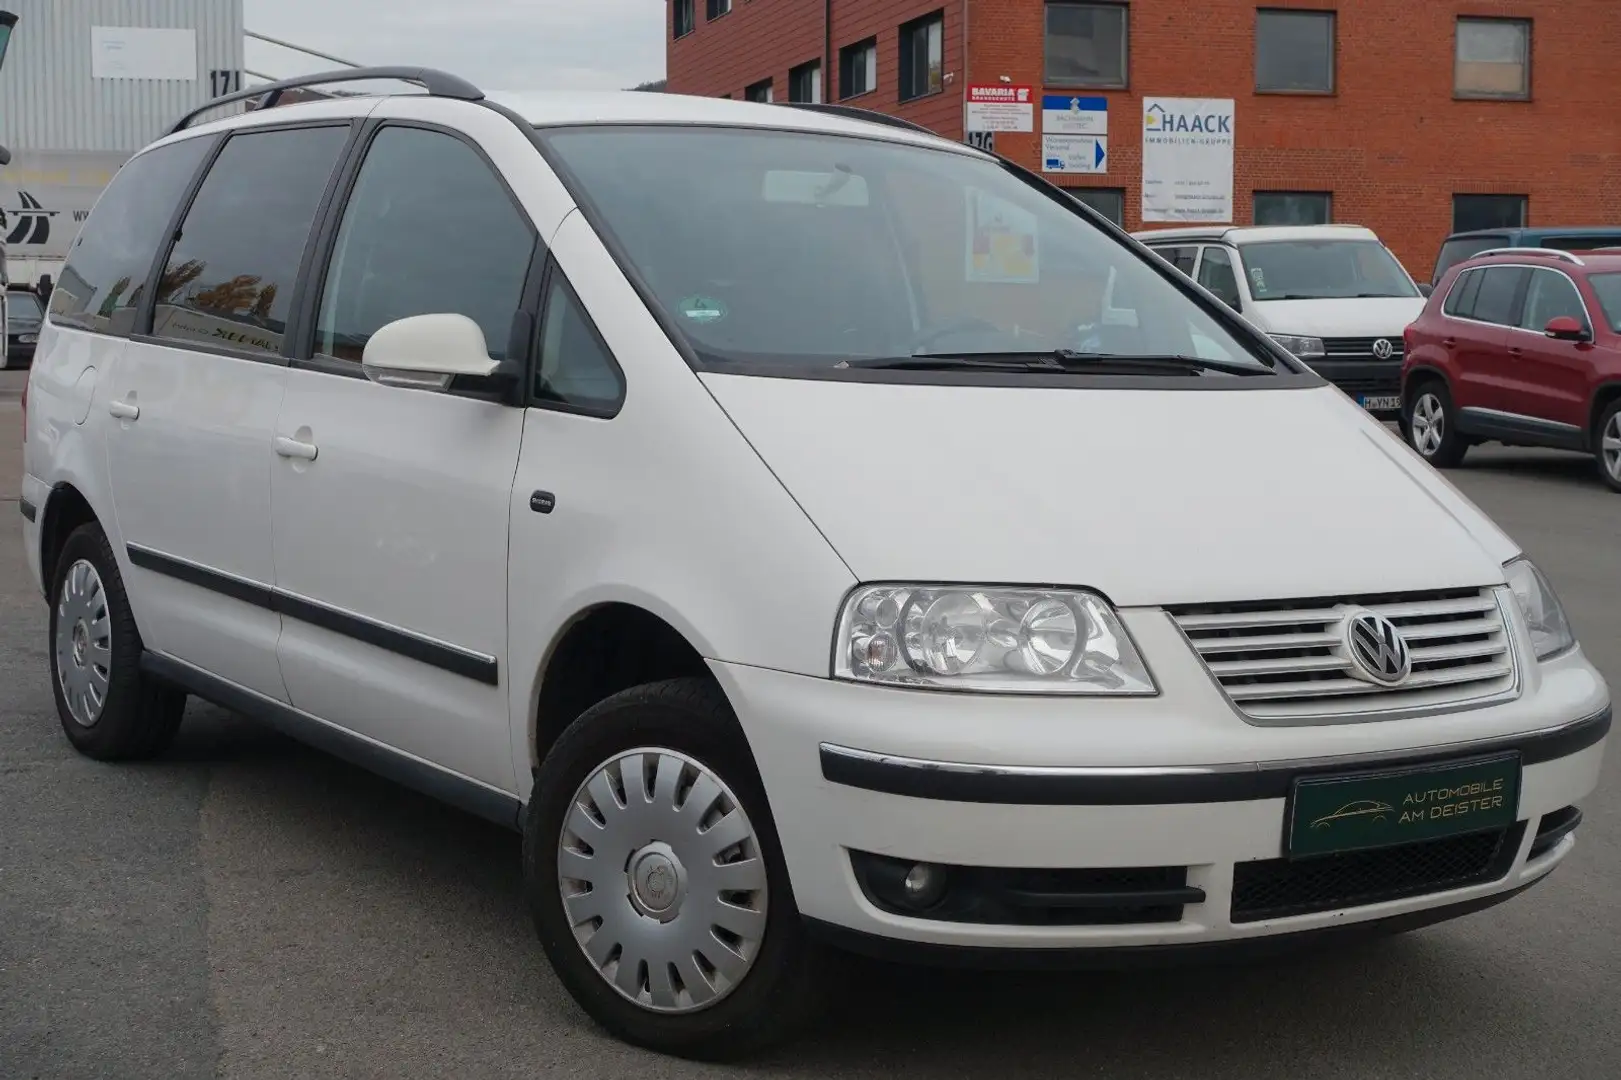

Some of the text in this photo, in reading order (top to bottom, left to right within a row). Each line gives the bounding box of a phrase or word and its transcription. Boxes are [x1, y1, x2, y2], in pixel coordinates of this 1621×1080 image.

[971, 87, 1015, 97] BAVARIA
[1162, 114, 1232, 133] HAACK
[1145, 136, 1232, 145] IMMOBILIEN-GRUPPE
[1402, 778, 1504, 805] AUTOMOBILE
[1398, 796, 1504, 824] AM DEISTER
